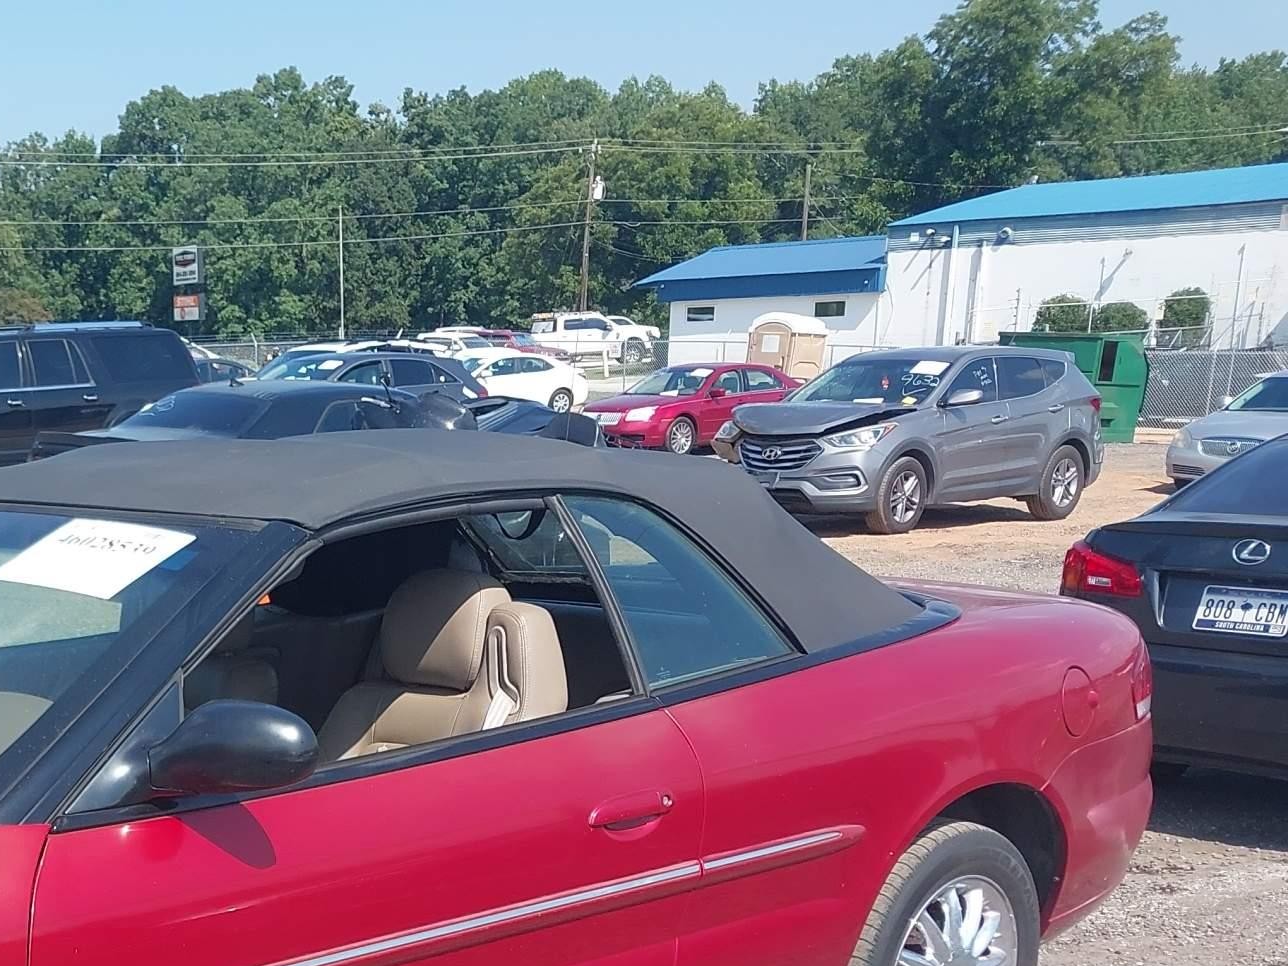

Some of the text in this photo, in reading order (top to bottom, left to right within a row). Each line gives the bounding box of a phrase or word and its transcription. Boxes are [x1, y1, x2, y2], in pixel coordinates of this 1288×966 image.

[1203, 598, 1288, 625] 808 CBM
[1214, 621, 1265, 632] SOUTH CAROLINA
